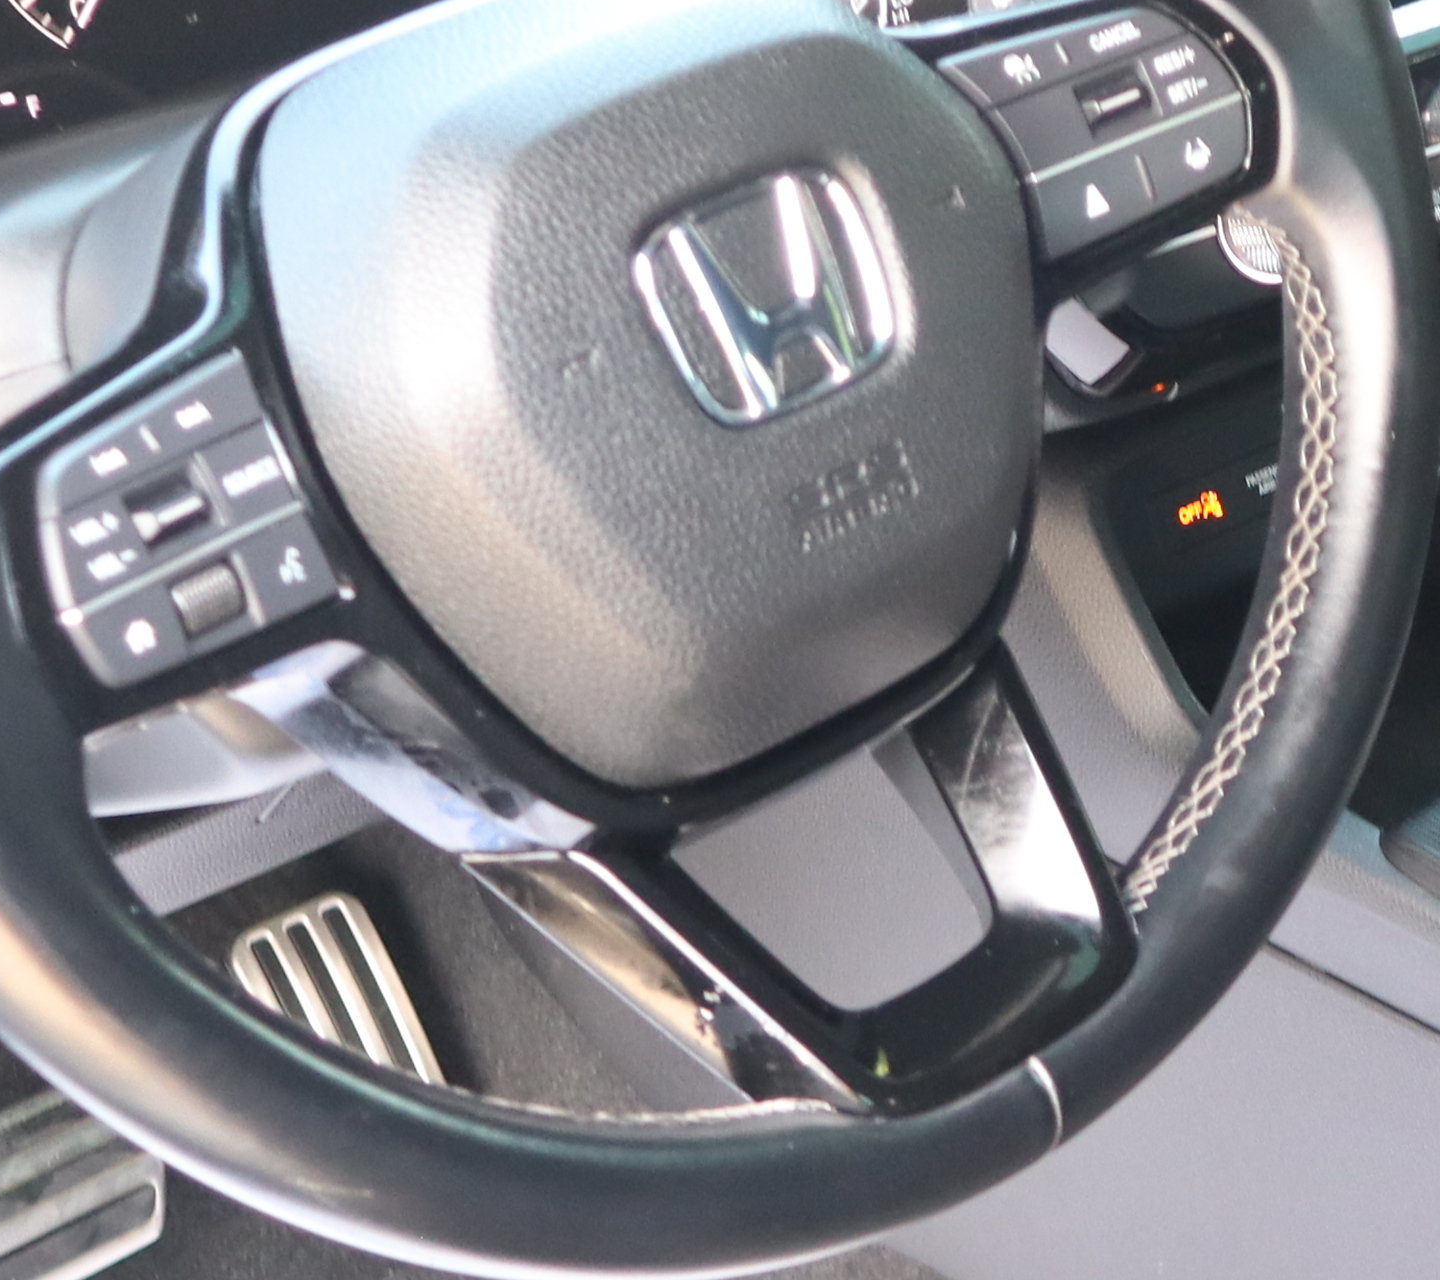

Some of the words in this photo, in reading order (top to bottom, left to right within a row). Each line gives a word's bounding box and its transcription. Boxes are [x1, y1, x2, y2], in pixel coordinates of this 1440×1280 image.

[891, 6, 911, 26] HI
[1089, 20, 1142, 54] CANCEL
[1178, 499, 1203, 526] OFF
